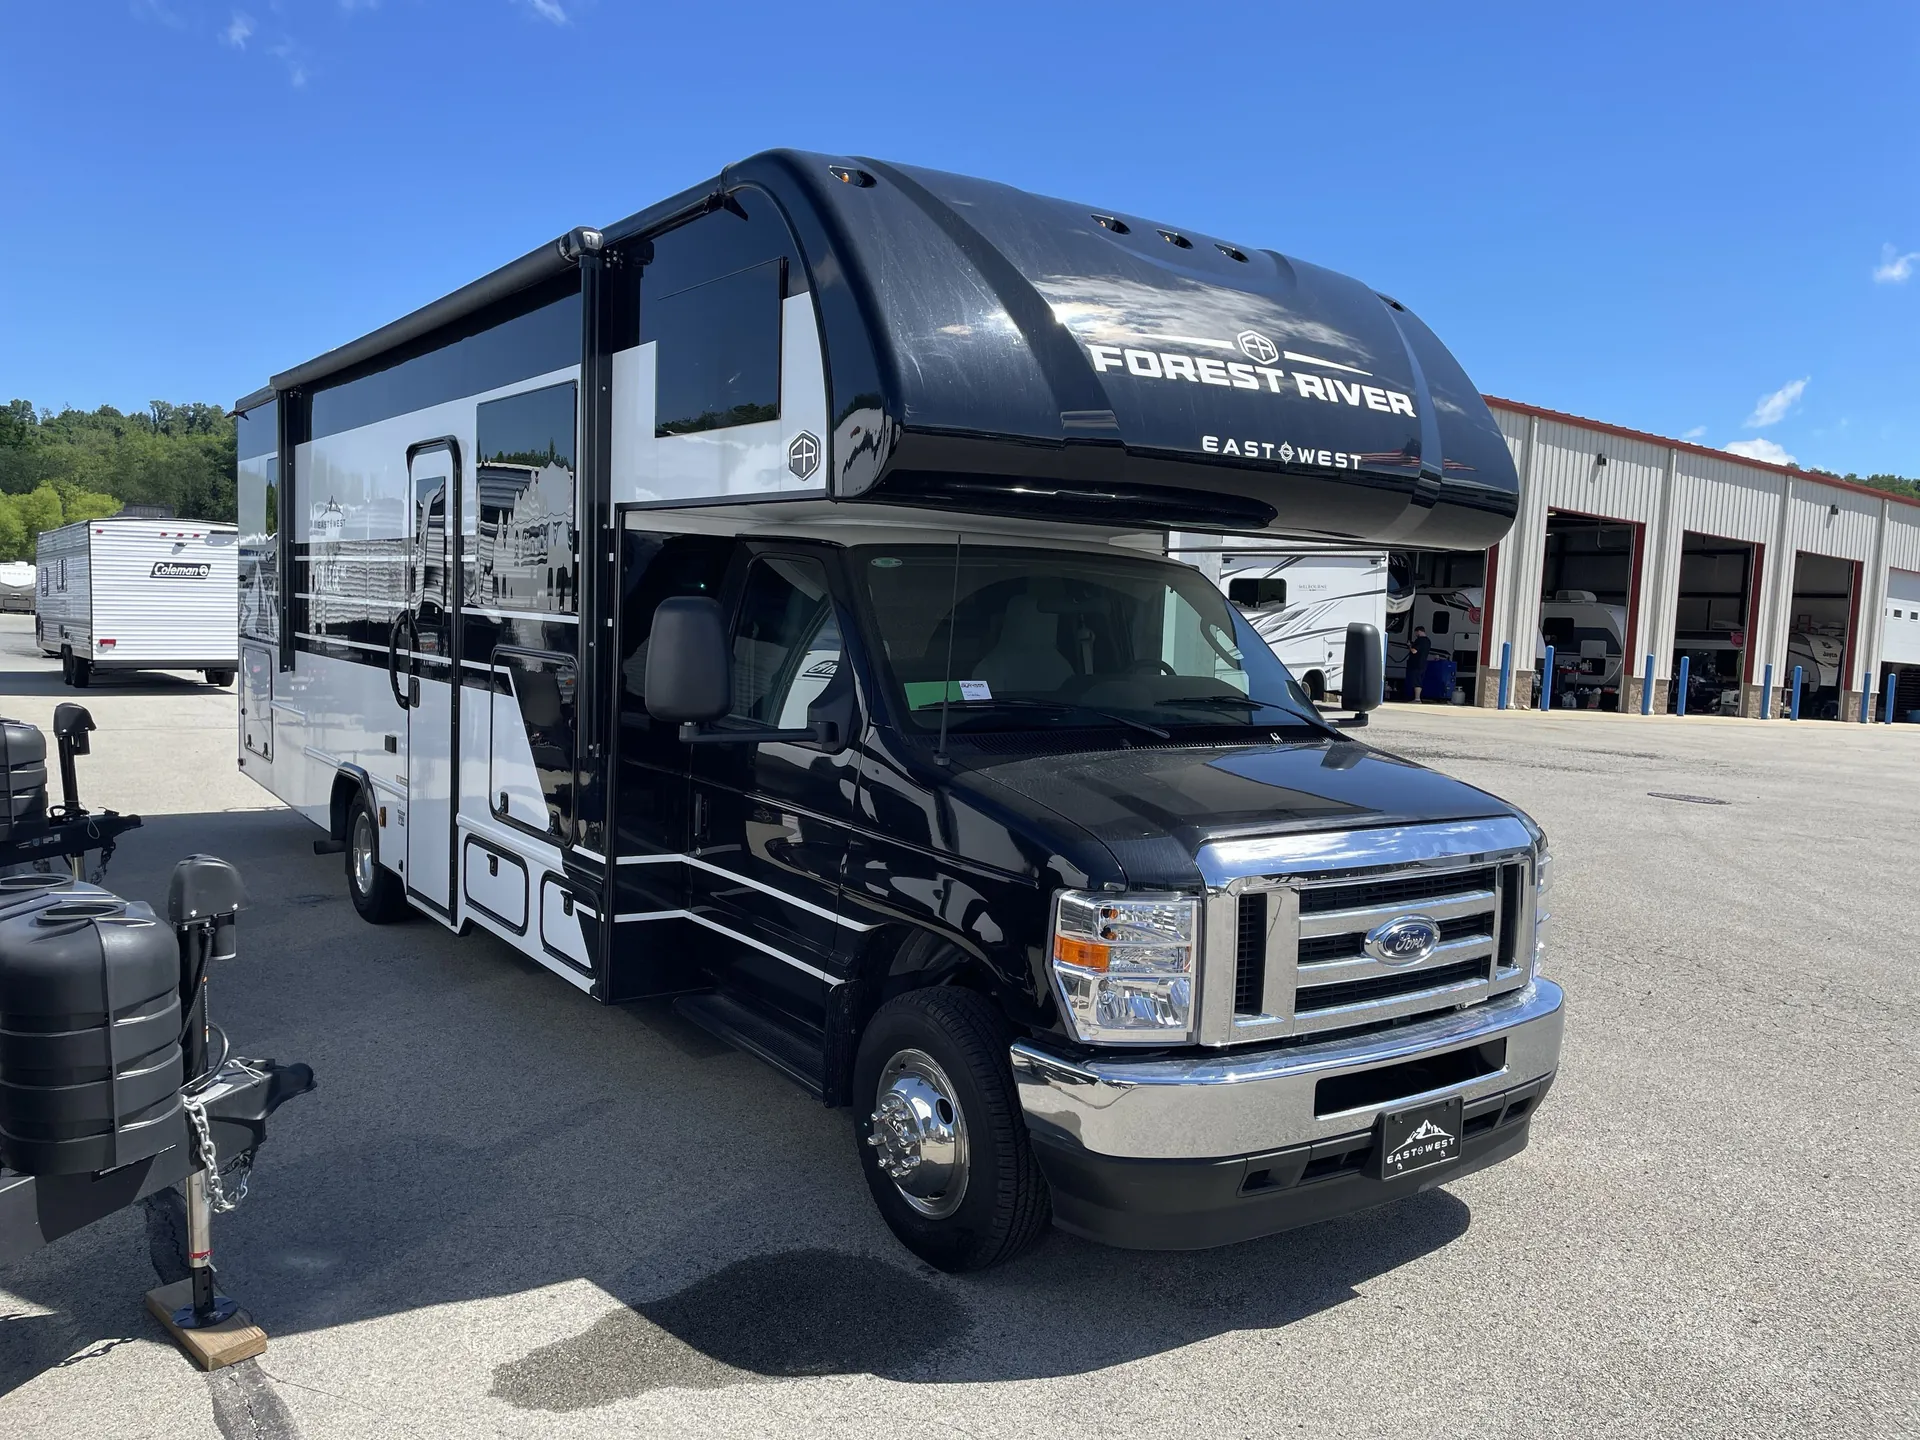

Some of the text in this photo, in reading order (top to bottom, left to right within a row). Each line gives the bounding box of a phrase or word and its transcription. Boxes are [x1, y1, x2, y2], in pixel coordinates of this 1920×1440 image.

[1085, 344, 1416, 418] FOREST RIVER
[1202, 435, 1274, 459] EAST
[1297, 447, 1361, 470] WEST
[154, 563, 199, 576] Coleman
[1395, 929, 1427, 952] Ford
[1386, 1137, 1455, 1165] EAST WEST
